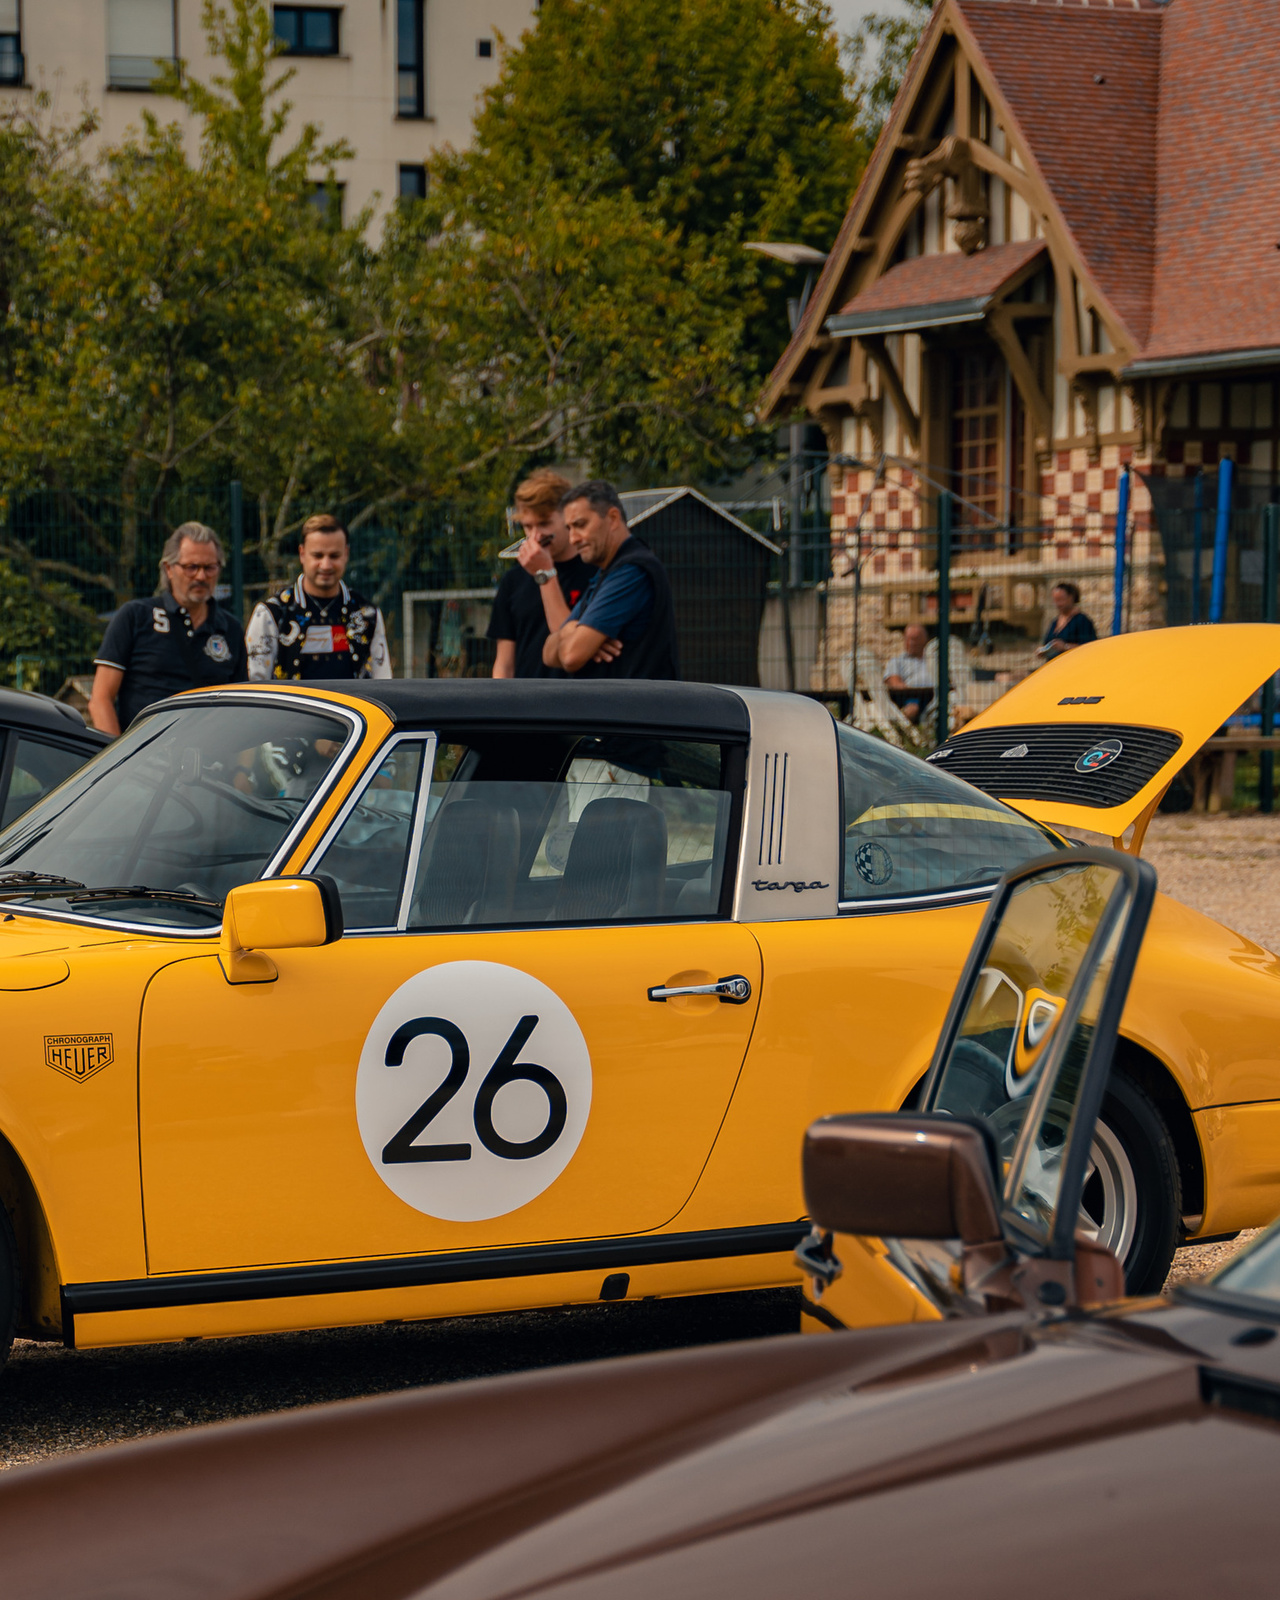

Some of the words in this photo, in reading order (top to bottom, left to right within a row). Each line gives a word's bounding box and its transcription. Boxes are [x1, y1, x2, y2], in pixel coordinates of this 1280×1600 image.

[751, 879, 830, 893] targa
[46, 1035, 111, 1045] CHRONOGRAPH
[52, 1047, 108, 1075] HEUER
[382, 1015, 568, 1164] 26
